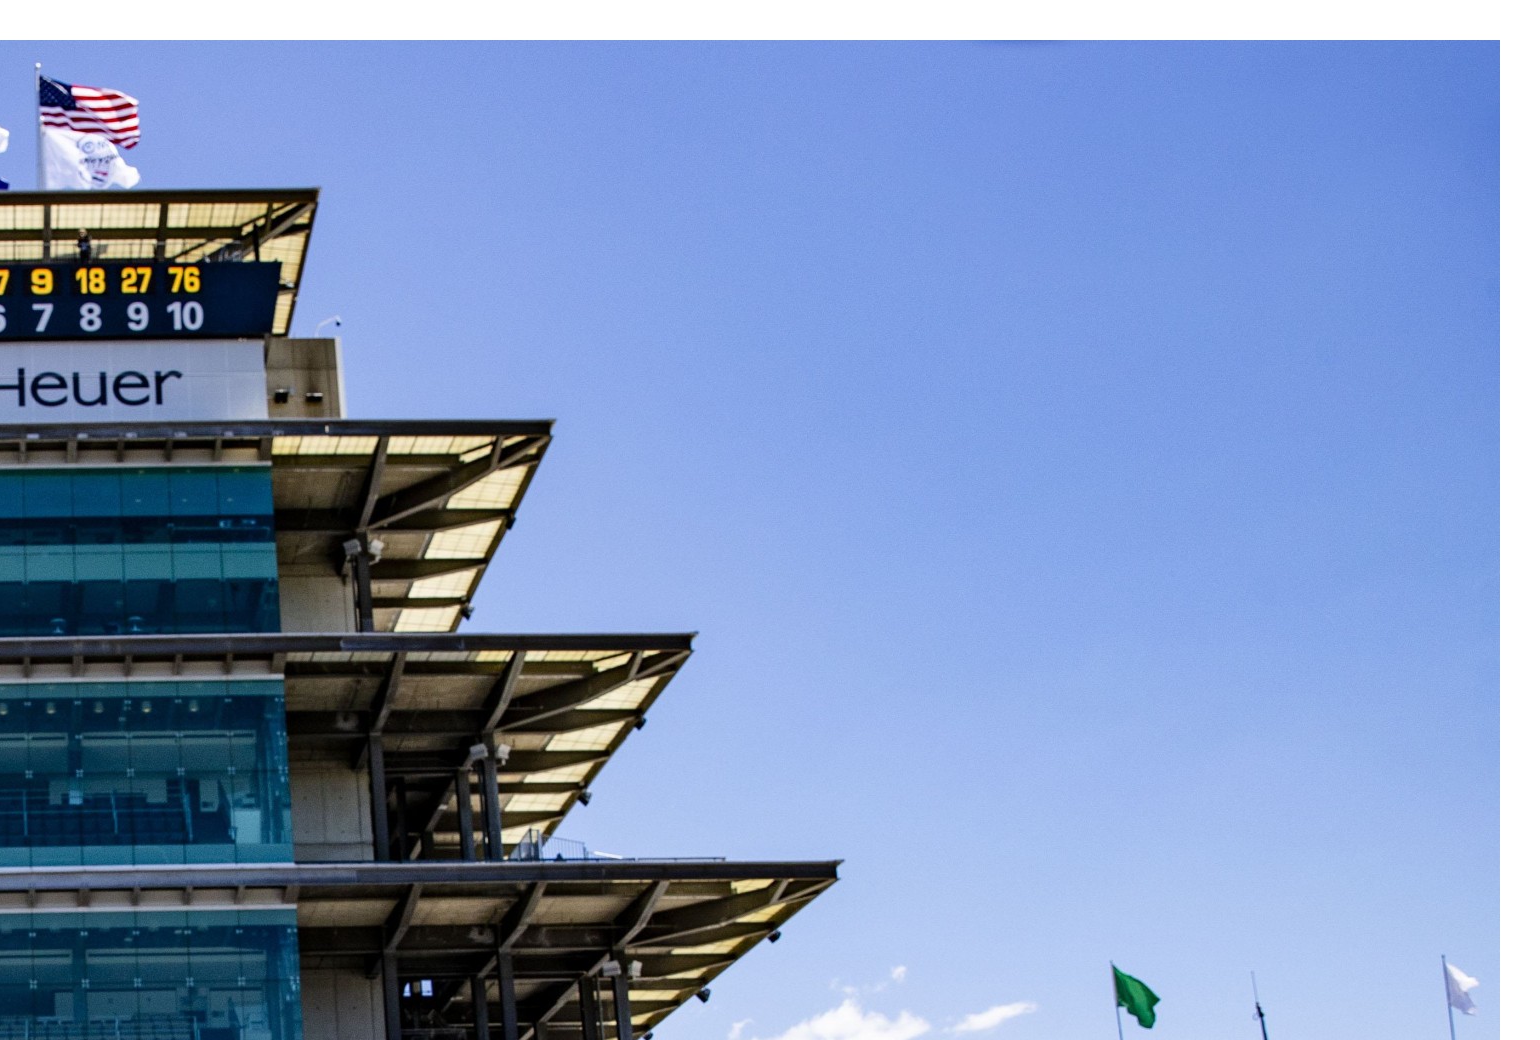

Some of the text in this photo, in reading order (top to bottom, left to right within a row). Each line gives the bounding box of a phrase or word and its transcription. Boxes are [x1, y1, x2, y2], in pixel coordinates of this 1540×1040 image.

[30, 268, 54, 295] 9
[75, 267, 106, 294] 18
[121, 267, 152, 293] 27
[168, 266, 201, 293] 76
[31, 303, 54, 332] 7
[79, 302, 102, 332] 8
[126, 301, 149, 331] 9
[166, 301, 204, 331] 10
